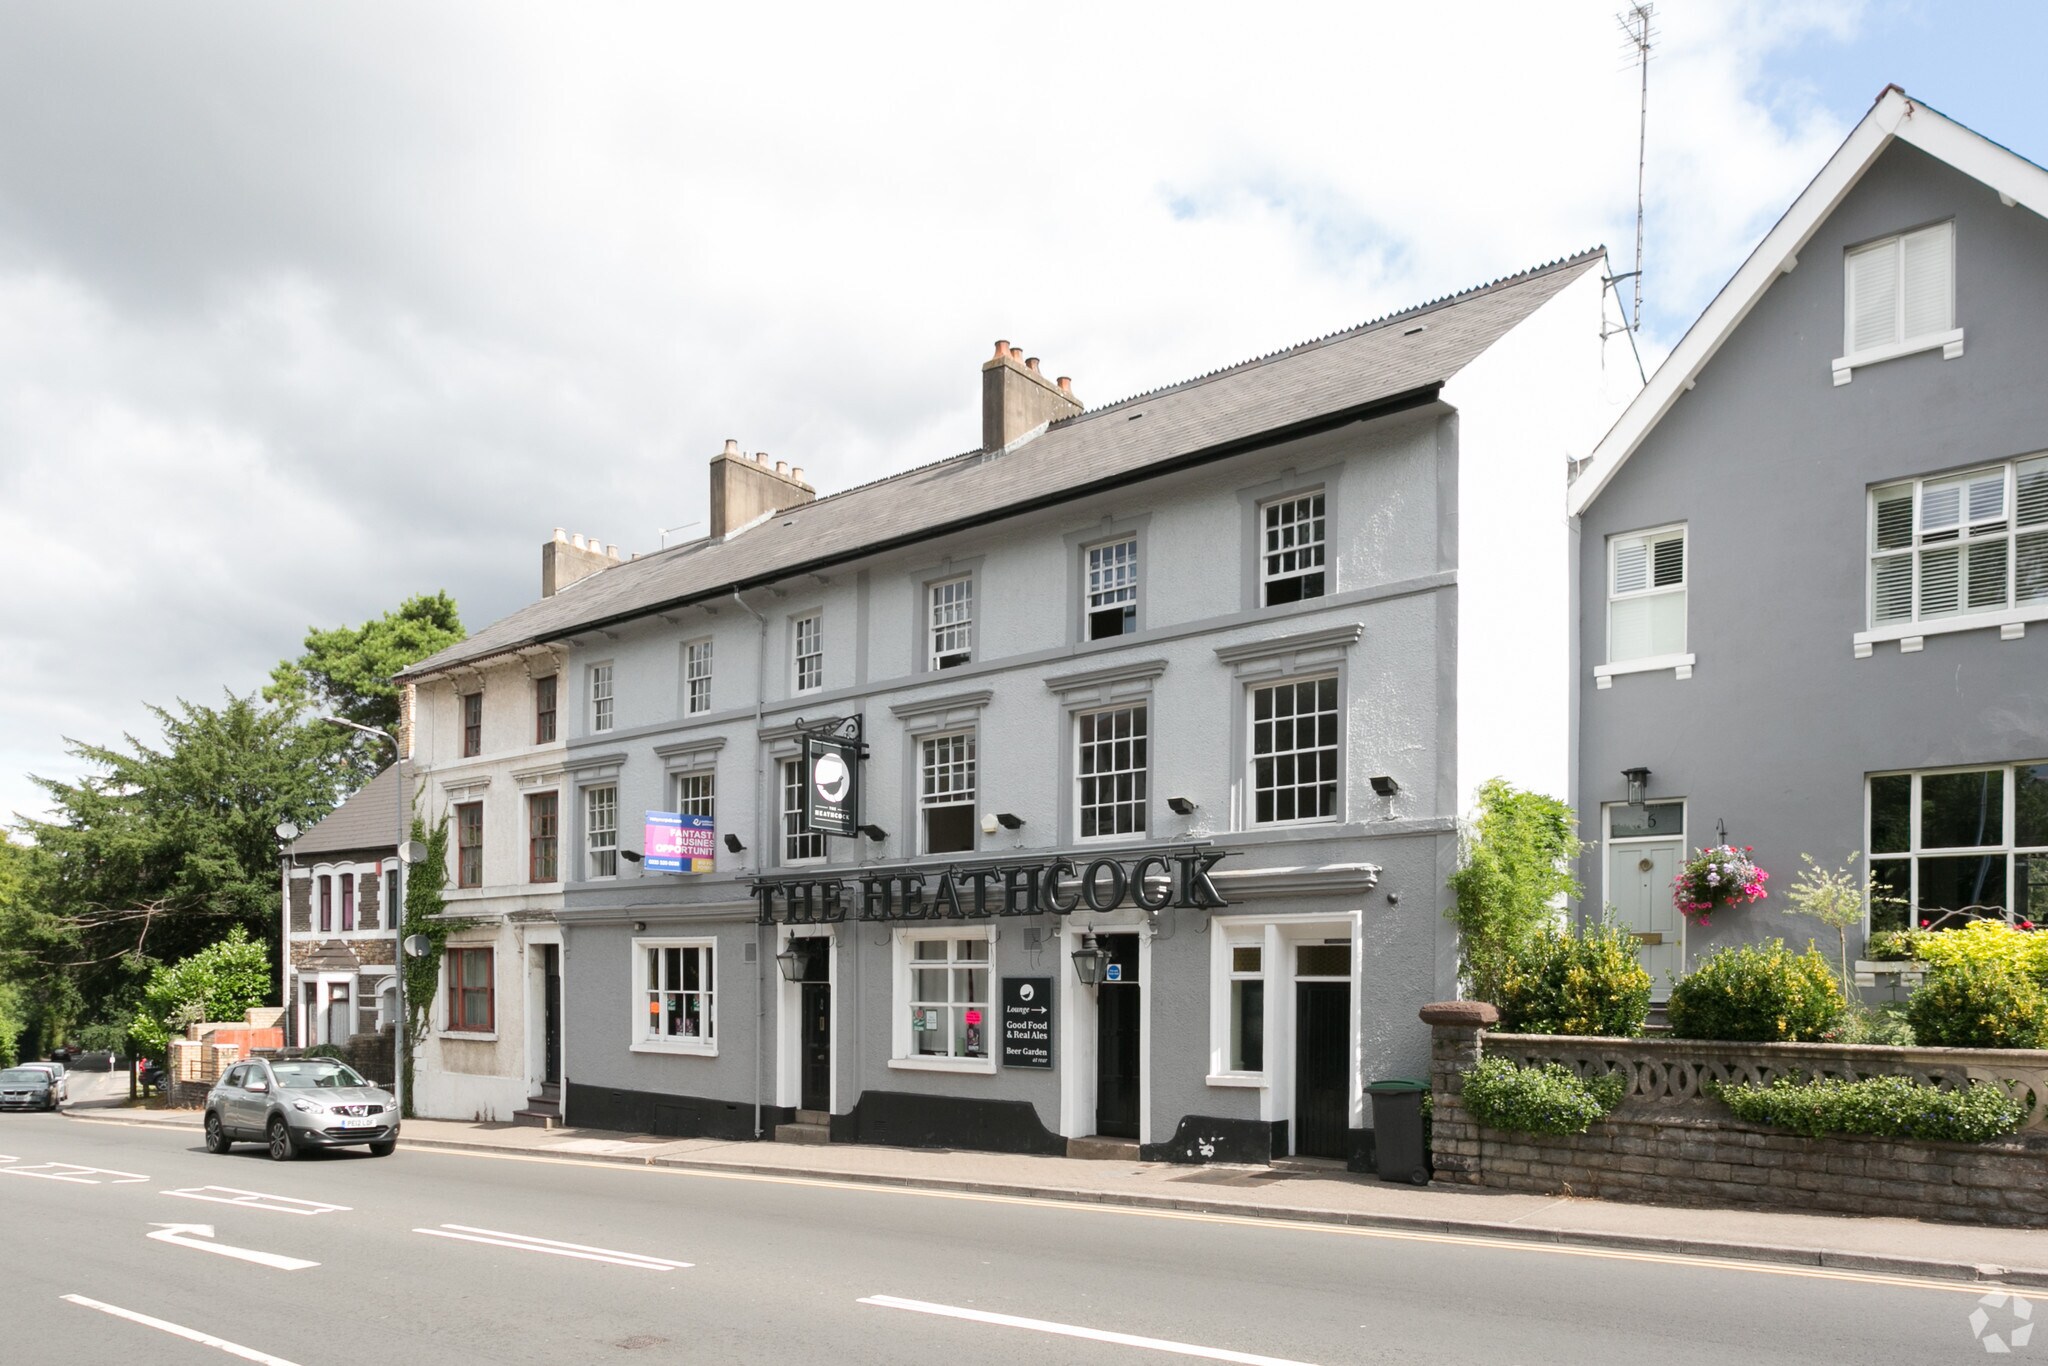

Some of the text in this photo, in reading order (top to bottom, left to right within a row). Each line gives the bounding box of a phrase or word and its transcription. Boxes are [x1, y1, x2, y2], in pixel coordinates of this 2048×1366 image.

[814, 810, 850, 820] HEATHCOCK
[750, 851, 1229, 926] THE HEATHCOCK
[1006, 1005, 1030, 1015] Lounge
[1006, 1020, 1048, 1030] Good Food
[1006, 1030, 1048, 1039] & Real Ales
[1006, 1046, 1048, 1056] Beer Garden
